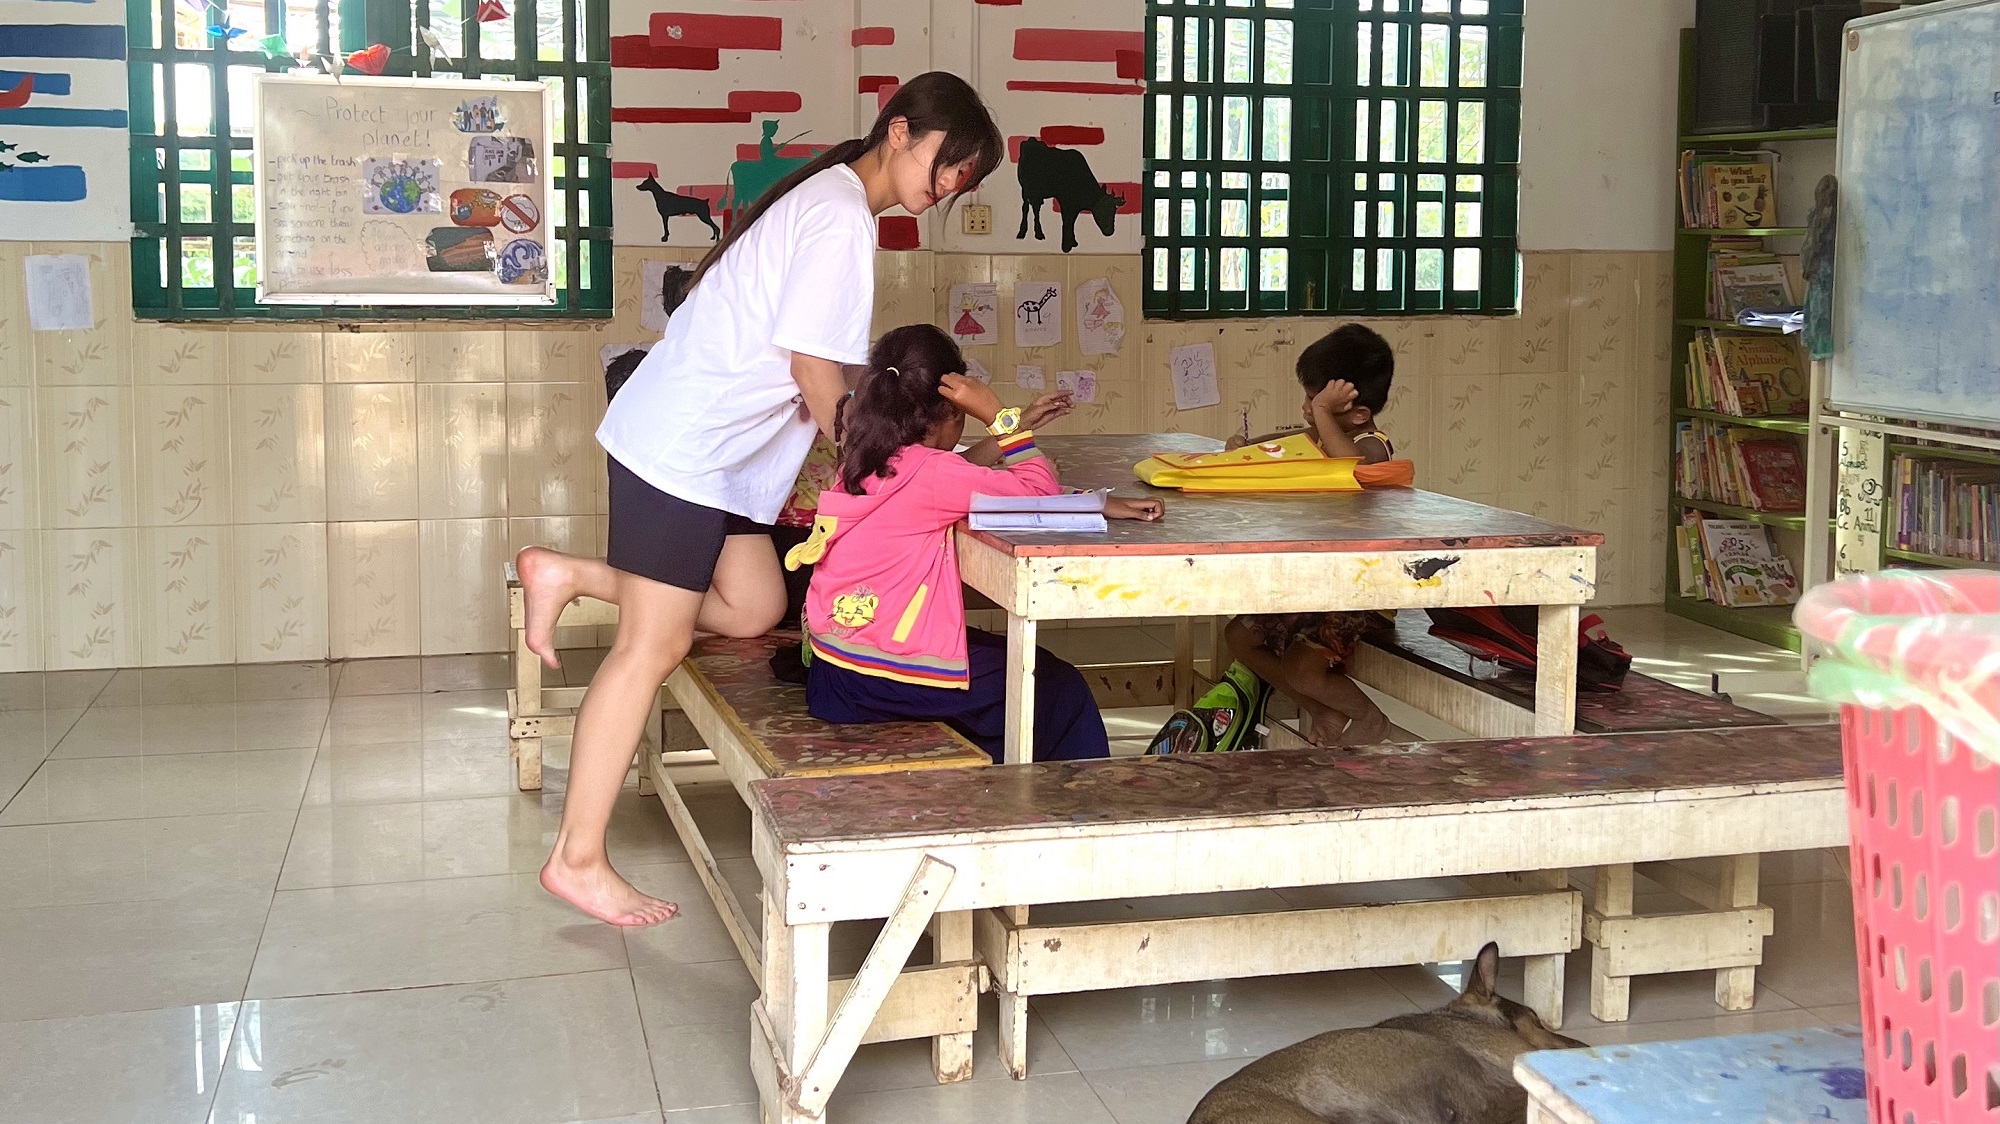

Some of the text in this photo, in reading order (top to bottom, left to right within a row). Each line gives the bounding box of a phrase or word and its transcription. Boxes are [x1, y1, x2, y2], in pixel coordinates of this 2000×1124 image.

[325, 95, 387, 124] Protect
[362, 129, 431, 151] planet!
[299, 156, 311, 169] up
[312, 155, 327, 166] the
[331, 154, 357, 168] trash
[1729, 167, 1753, 176] What
[1720, 176, 1730, 185] do
[1731, 178, 1745, 187] you
[1742, 344, 1779, 354] Animal
[1736, 354, 1789, 367] Alphabet
